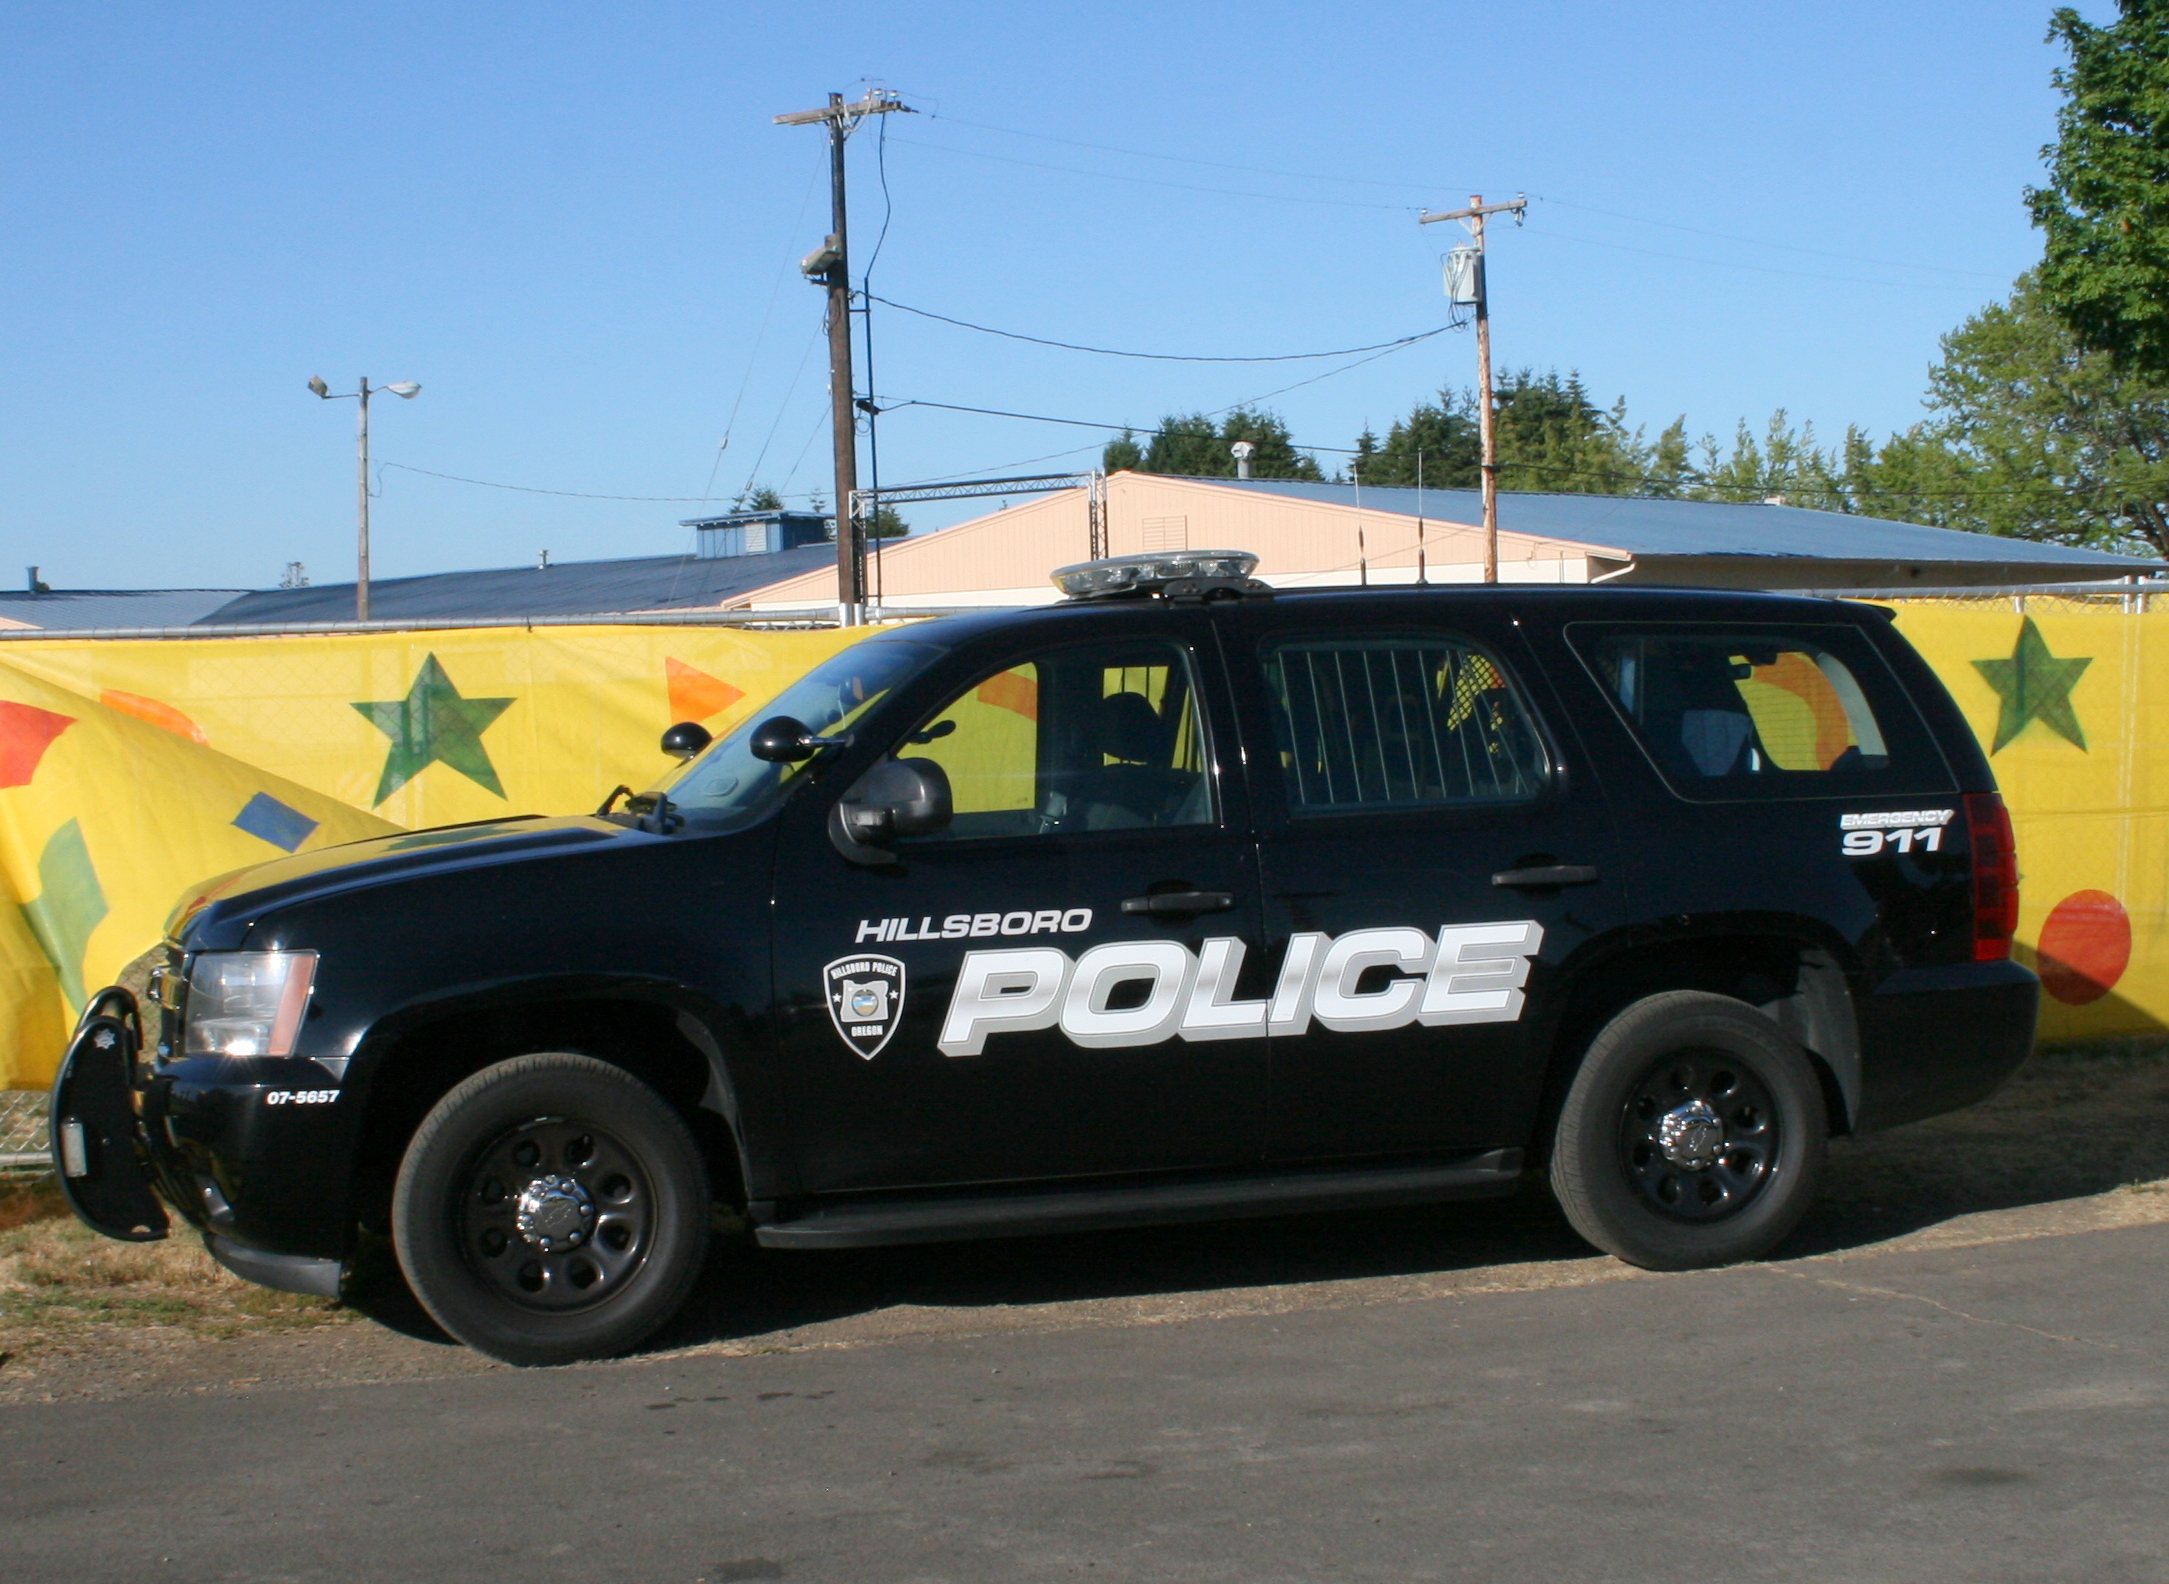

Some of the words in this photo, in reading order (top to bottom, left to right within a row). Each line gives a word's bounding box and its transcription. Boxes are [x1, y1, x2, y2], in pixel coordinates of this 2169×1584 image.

[1840, 809, 1954, 830] EMERGENCY
[1842, 827, 1942, 856] 911
[855, 908, 1093, 943] HILLSBORO
[830, 961, 870, 980] HILLSBORO
[872, 961, 898, 977] POLICE
[937, 920, 1545, 1057] POLICE
[851, 1025, 883, 1037] OREGON
[267, 1090, 340, 1105] 07-5657
